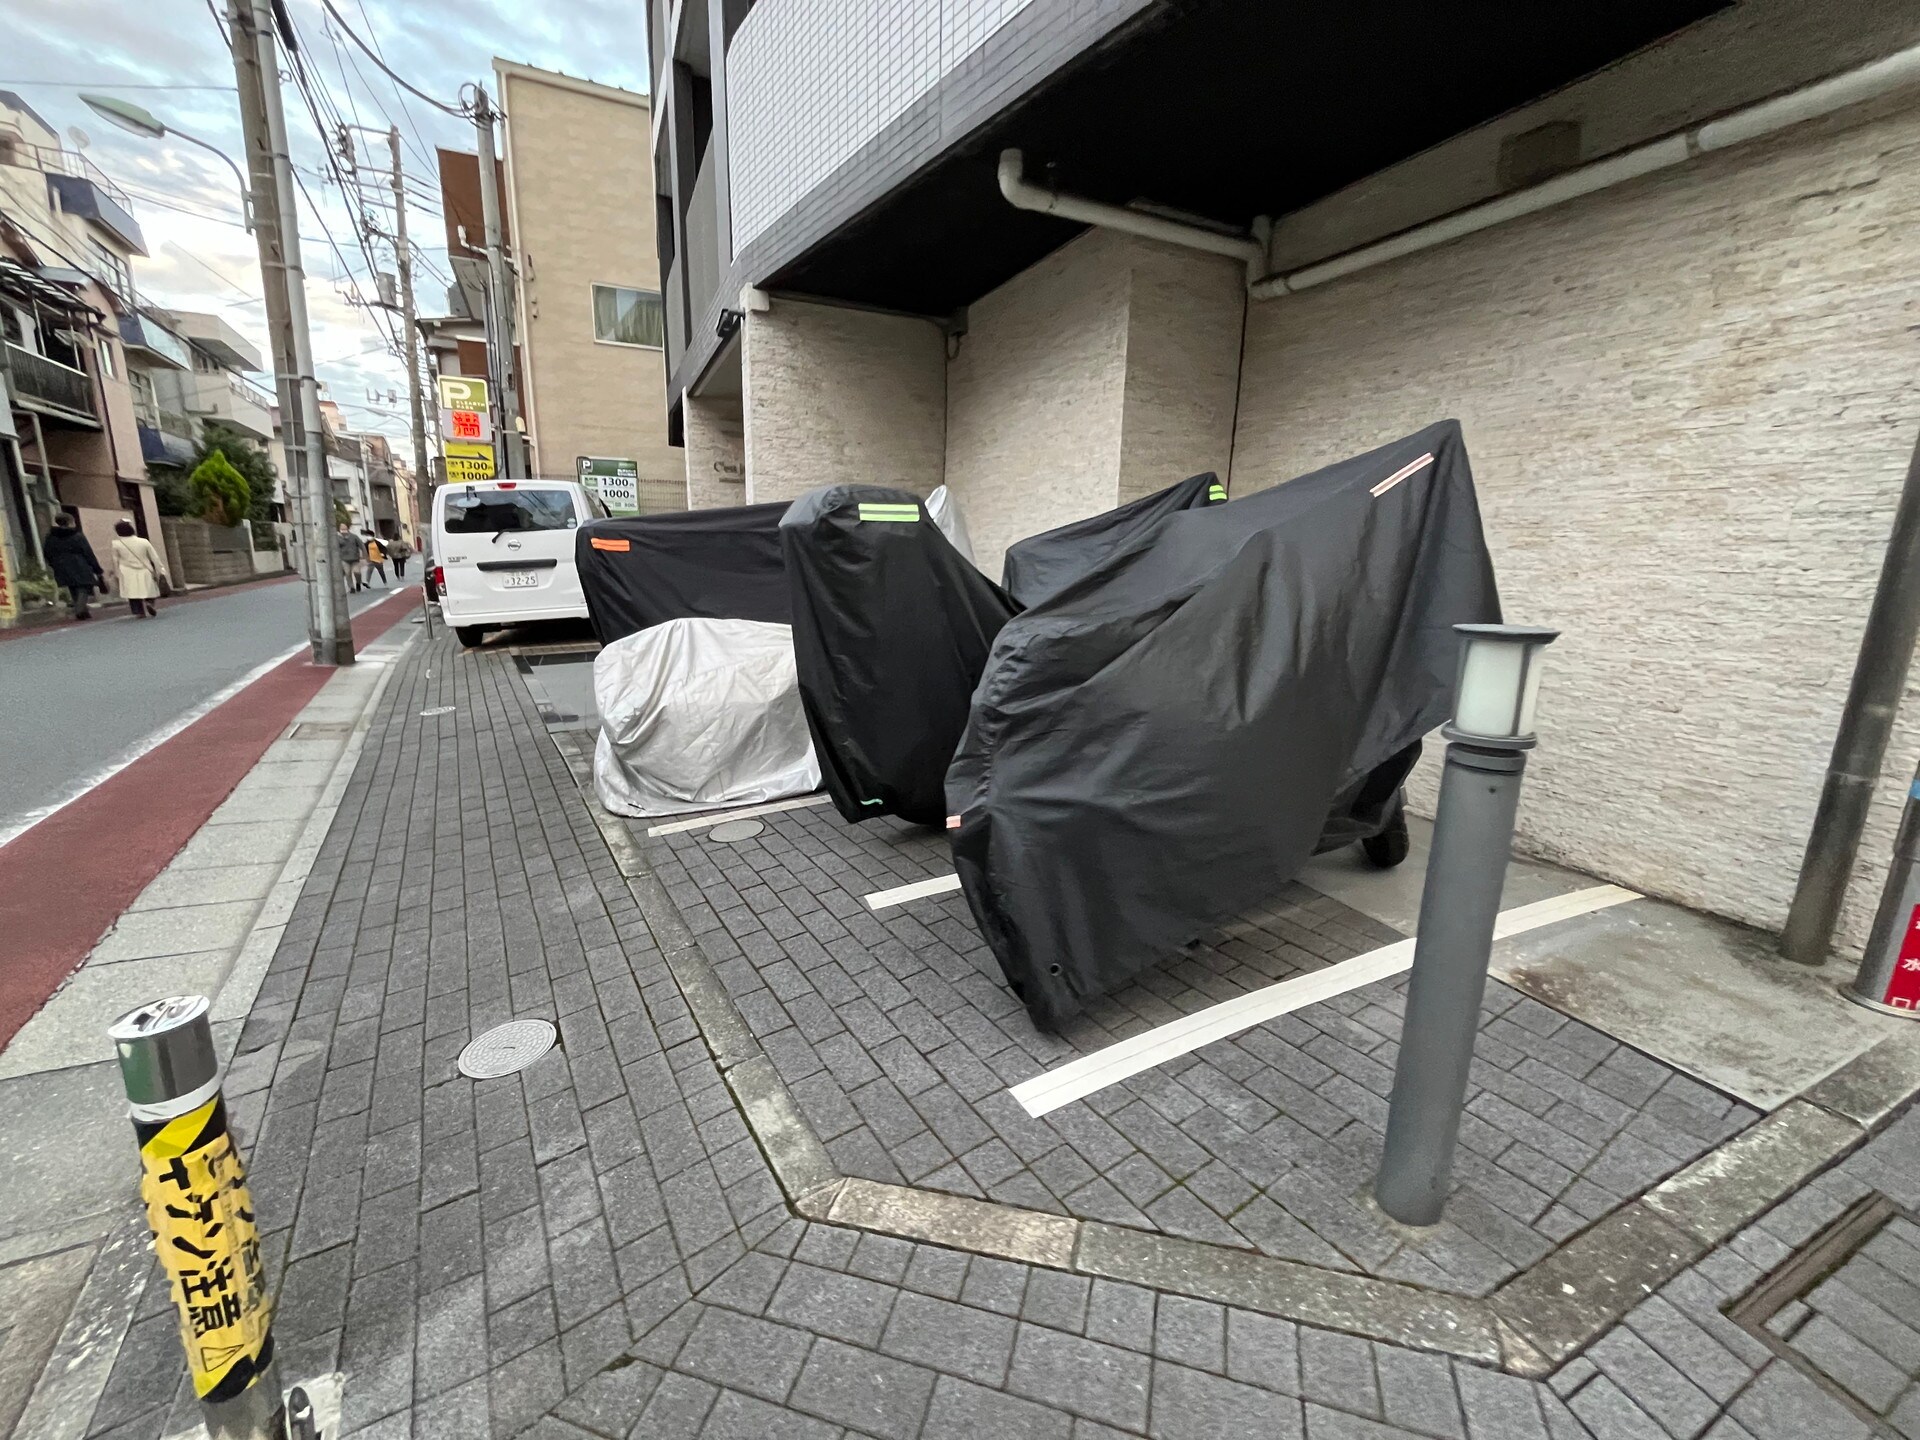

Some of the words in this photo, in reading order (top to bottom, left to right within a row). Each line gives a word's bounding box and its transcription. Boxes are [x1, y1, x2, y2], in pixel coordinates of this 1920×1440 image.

[441, 381, 472, 409] P
[453, 411, 480, 438] 満
[582, 460, 591, 469] P
